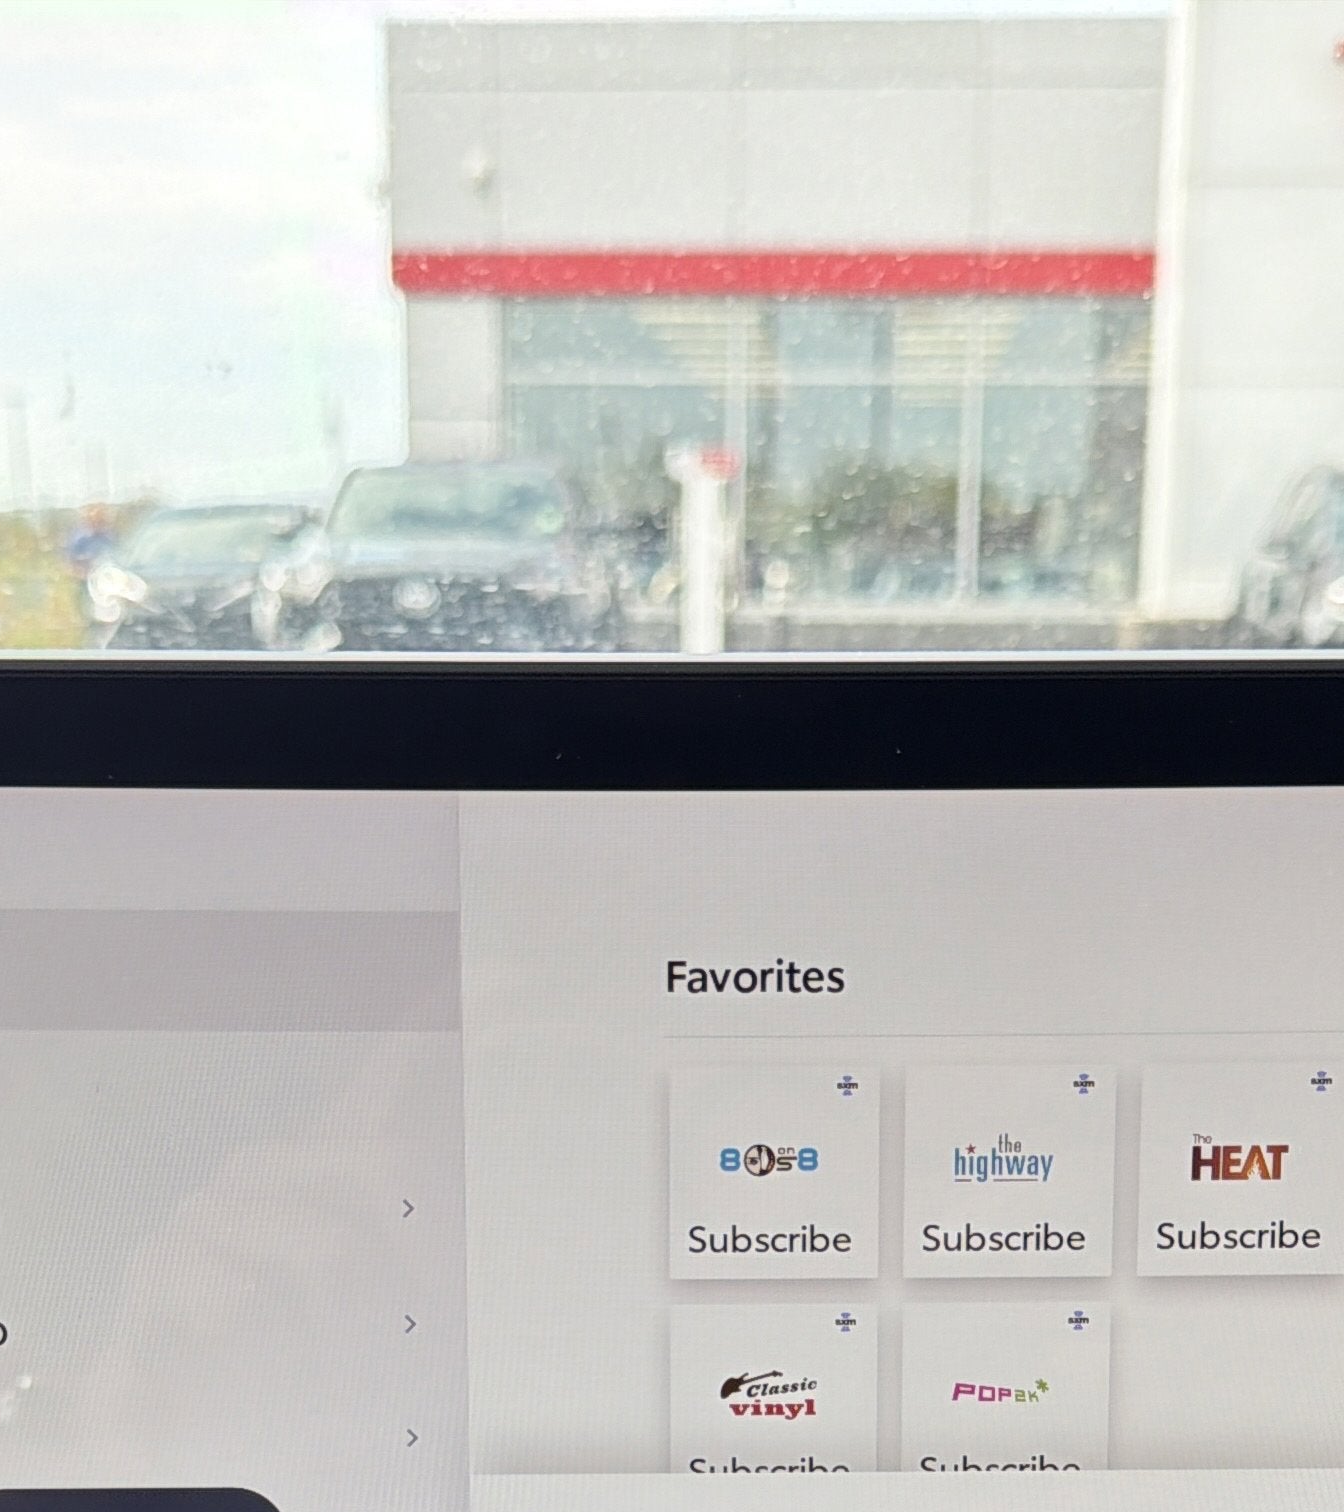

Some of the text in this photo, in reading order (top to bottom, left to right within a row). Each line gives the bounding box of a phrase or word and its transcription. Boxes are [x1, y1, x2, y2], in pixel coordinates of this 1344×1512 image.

[666, 957, 845, 994] Favorites
[997, 1133, 1022, 1153] the
[1193, 1134, 1213, 1144] The
[954, 1144, 1053, 1182] highway
[1191, 1144, 1289, 1181] HEAT
[688, 1223, 852, 1253] Subscribe
[922, 1222, 1086, 1252] Subscribe
[1156, 1219, 1321, 1249] Subscribe
[746, 1379, 818, 1398] Classic
[729, 1398, 817, 1420] vinyl
